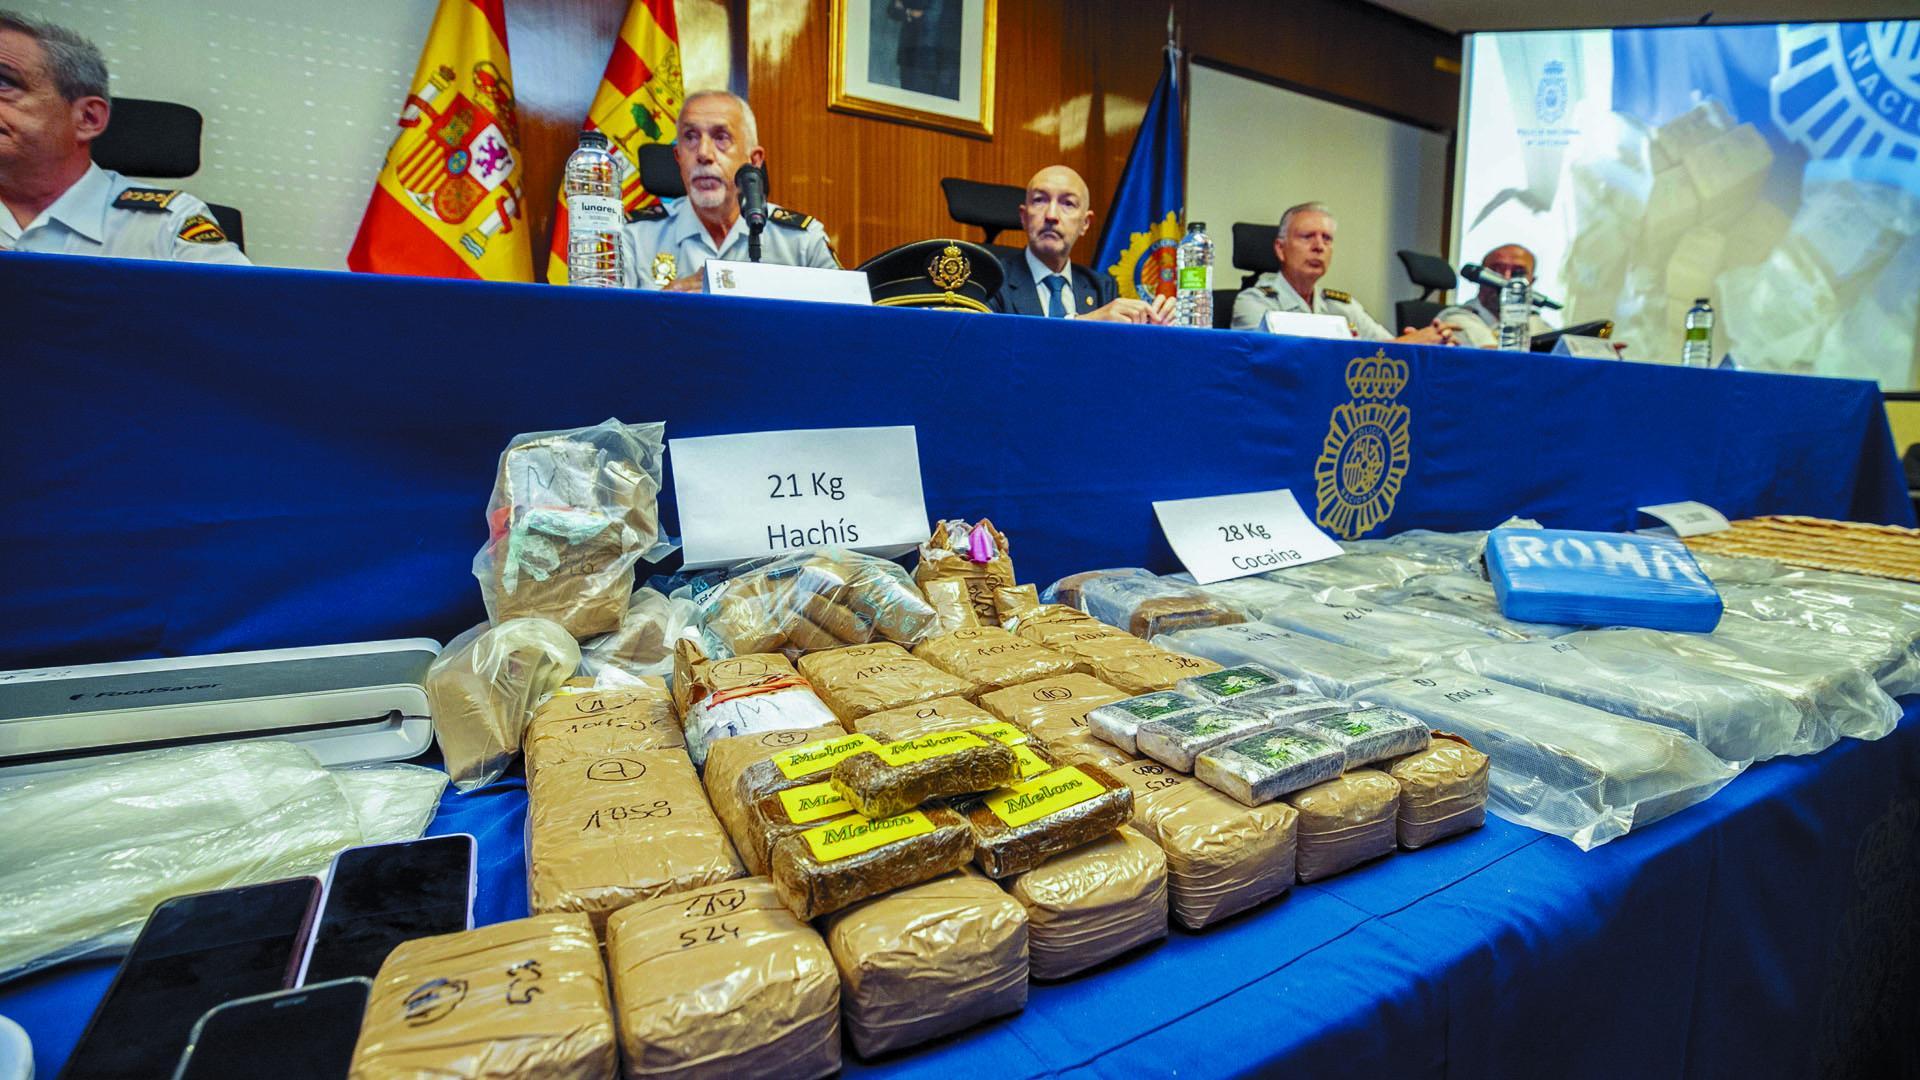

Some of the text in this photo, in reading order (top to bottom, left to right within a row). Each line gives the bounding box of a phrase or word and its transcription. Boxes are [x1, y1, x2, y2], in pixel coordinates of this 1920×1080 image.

[1846, 40, 1920, 129] NACI
[767, 471, 846, 501] 21 Kg
[767, 517, 860, 550] Hachís
[1218, 522, 1272, 543] 28 Kg
[1231, 548, 1303, 571] Cocaína
[94, 682, 222, 699] FoodSaver
[789, 738, 865, 767] Melon
[889, 733, 968, 756] Melon
[1003, 778, 1083, 815] Melon
[822, 817, 915, 846] Melon
